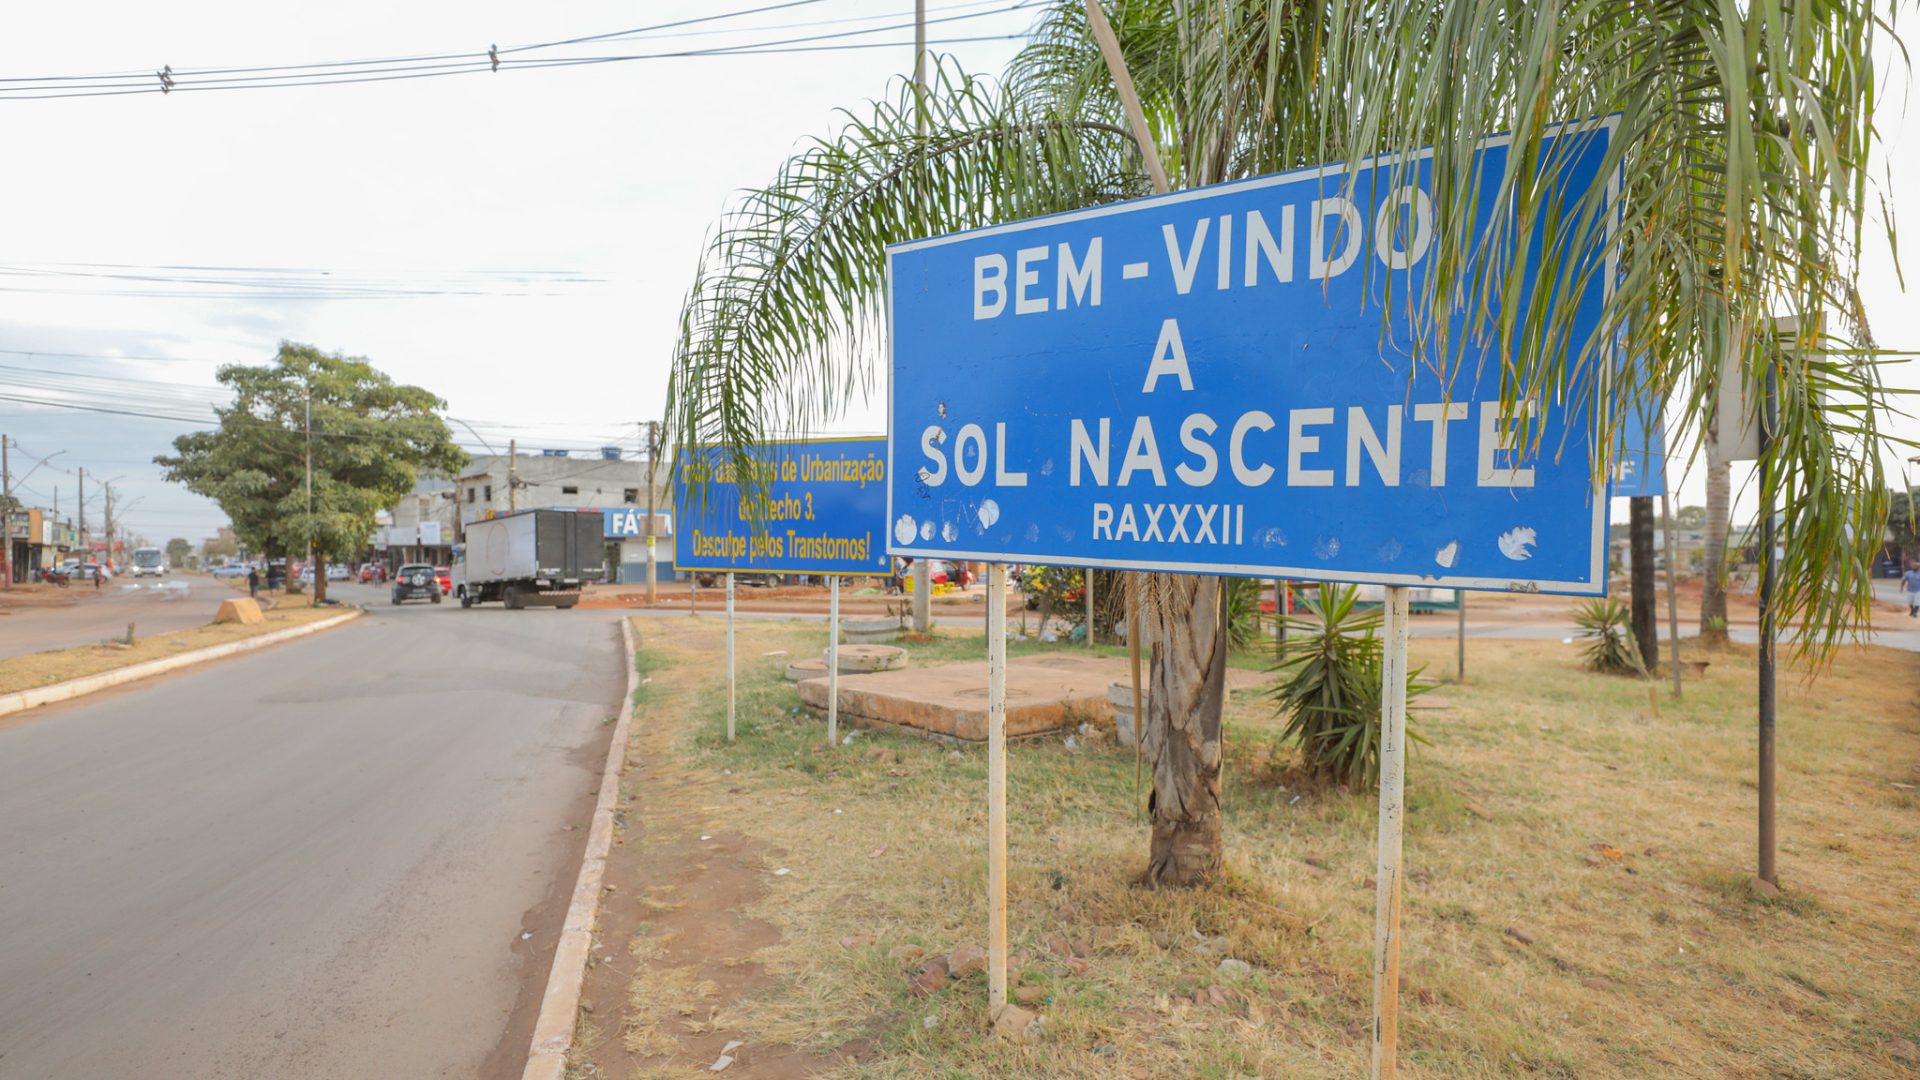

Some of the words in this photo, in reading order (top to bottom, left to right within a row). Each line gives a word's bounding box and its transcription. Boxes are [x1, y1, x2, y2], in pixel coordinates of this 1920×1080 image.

[1142, 318, 1194, 393] A
[918, 422, 1028, 487] SOL
[1070, 400, 1536, 488] NASCENTE
[781, 454, 798, 482] de
[801, 453, 885, 488] Urbanização
[1092, 502, 1244, 546] RAXXXII
[692, 529, 747, 564] Desculpe
[750, 529, 784, 563] pelos
[787, 530, 871, 561] Transtornos!
